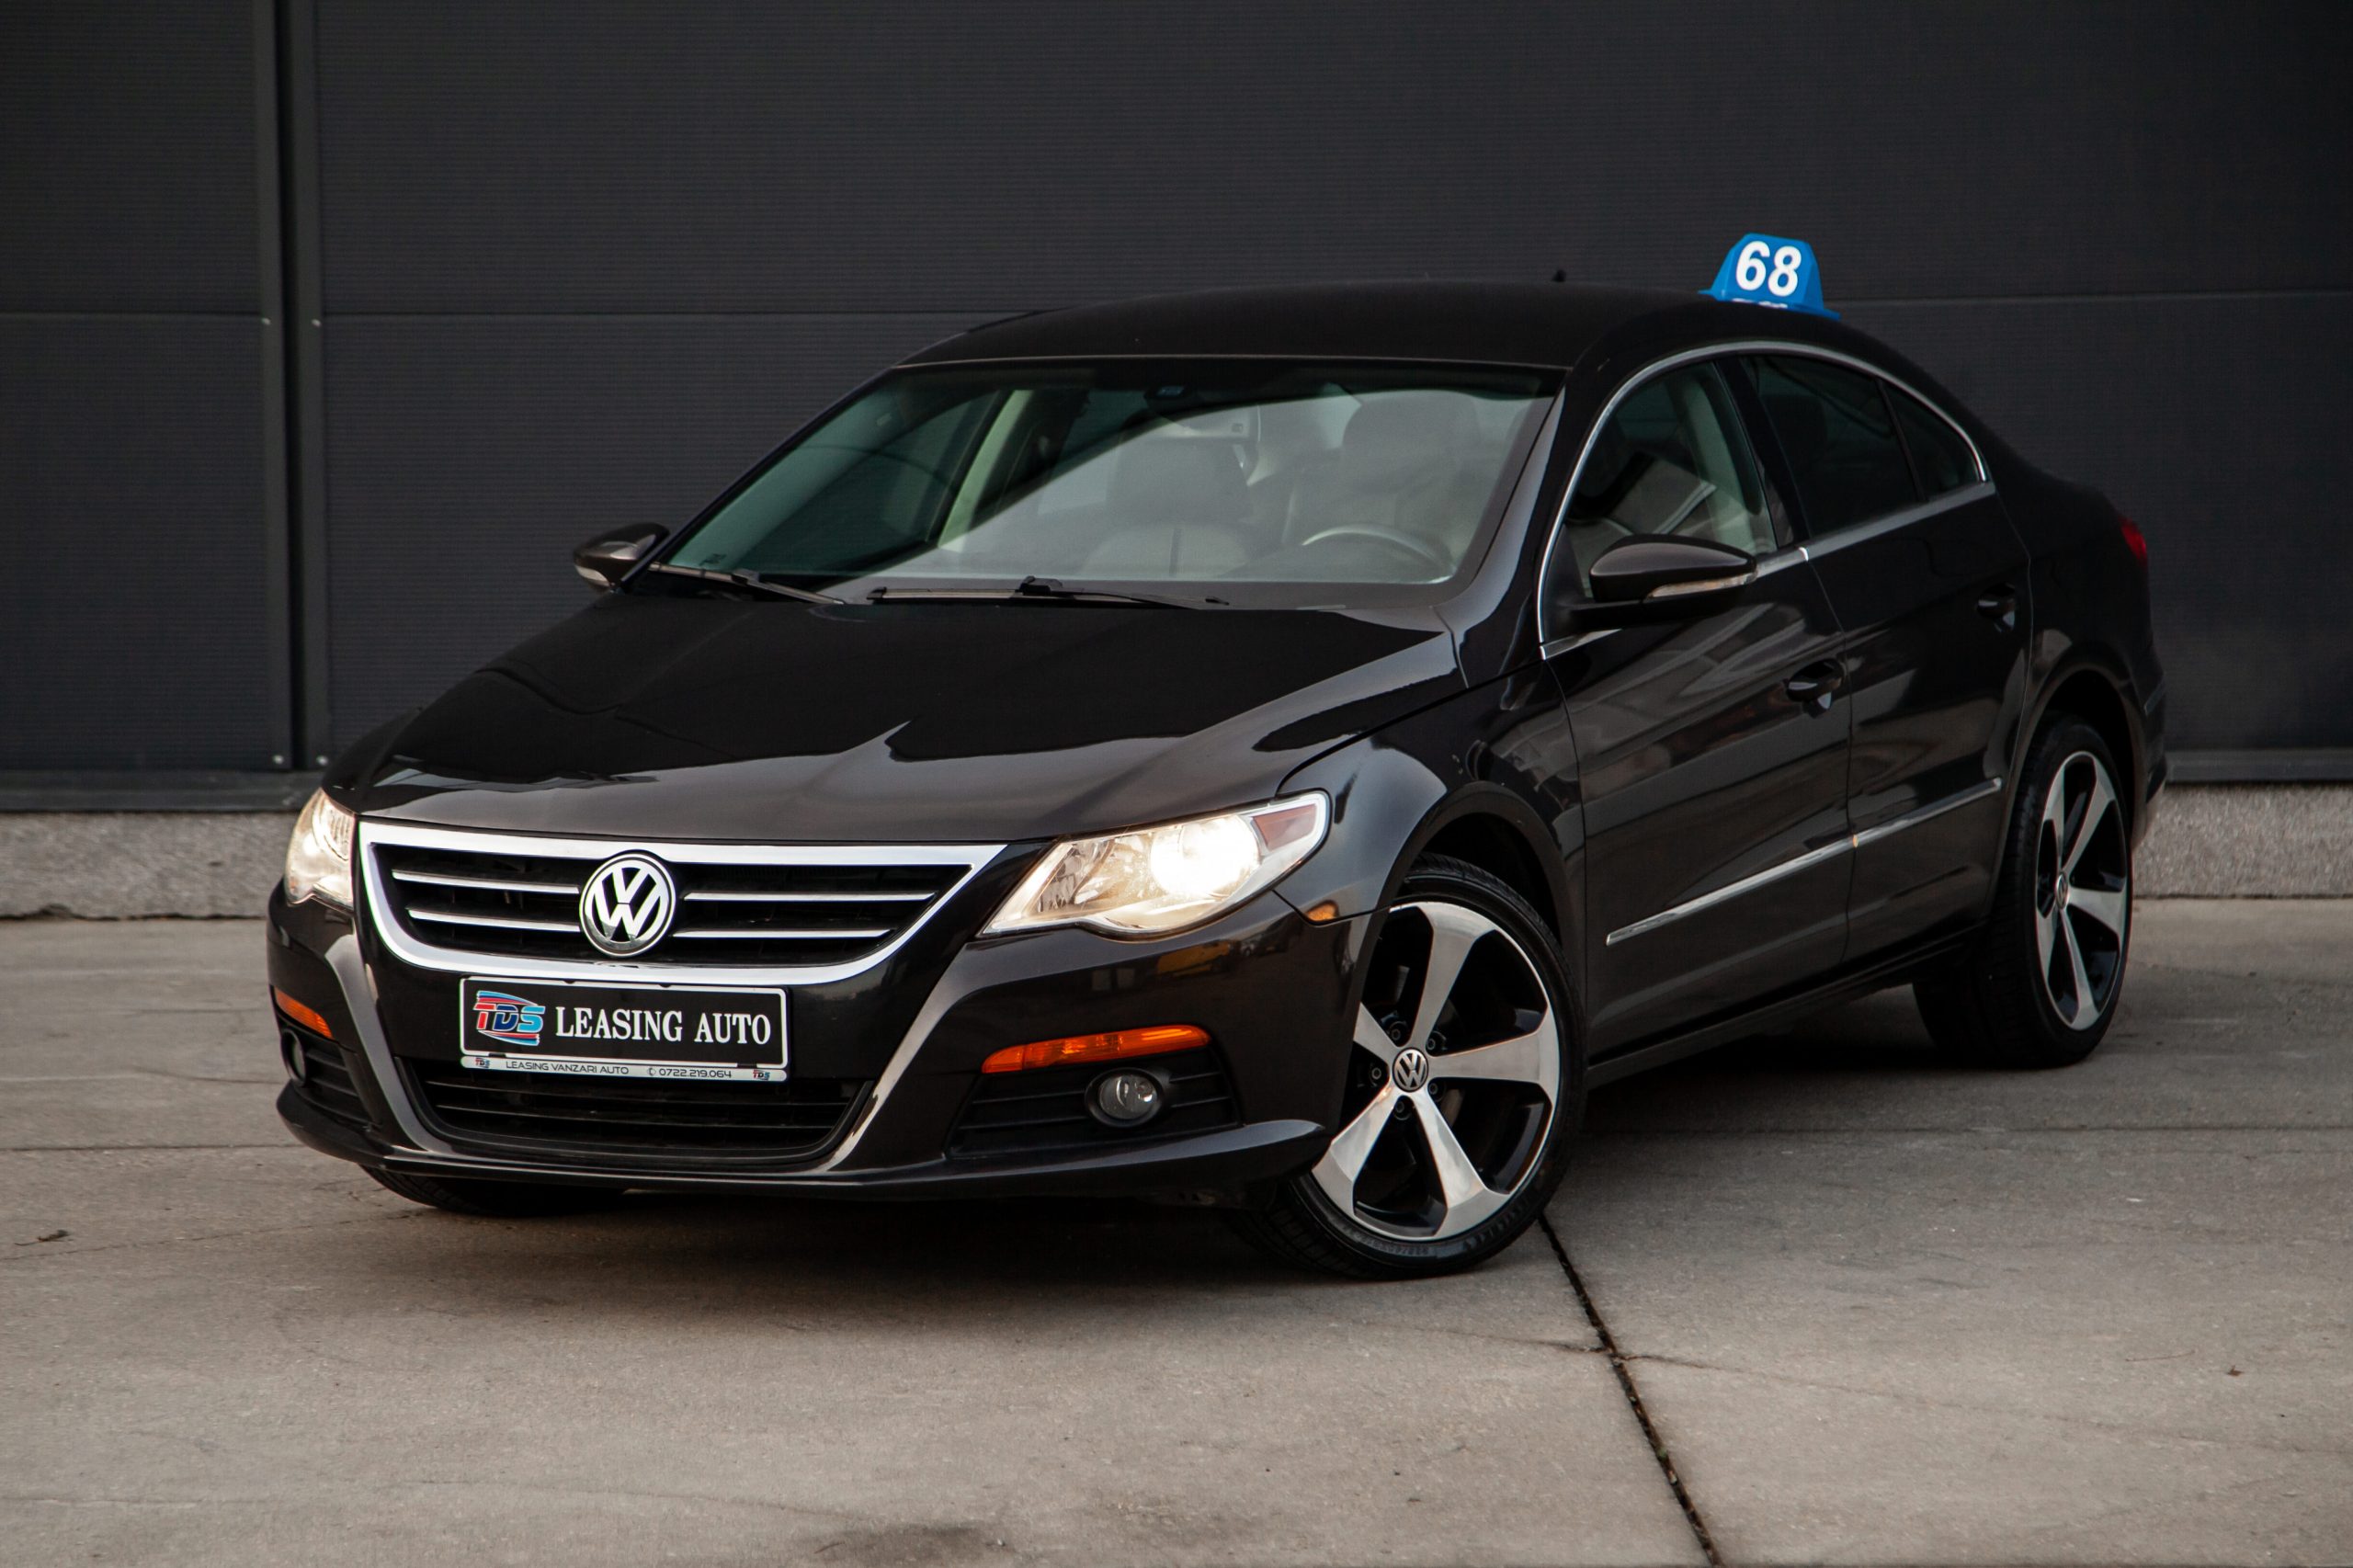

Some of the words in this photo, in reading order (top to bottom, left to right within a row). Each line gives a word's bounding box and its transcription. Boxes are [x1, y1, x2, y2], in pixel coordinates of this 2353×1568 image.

[1735, 240, 1802, 298] 68
[584, 858, 671, 951] VW
[472, 1002, 547, 1034] TDS
[555, 1006, 684, 1043] LEASING
[693, 1012, 772, 1046] AUTO
[506, 1061, 550, 1072] LEASING
[551, 1063, 598, 1074] VANZARI
[599, 1066, 630, 1075] AUTO
[658, 1068, 733, 1079] 0722.219.064
[752, 1070, 771, 1080] TDS
